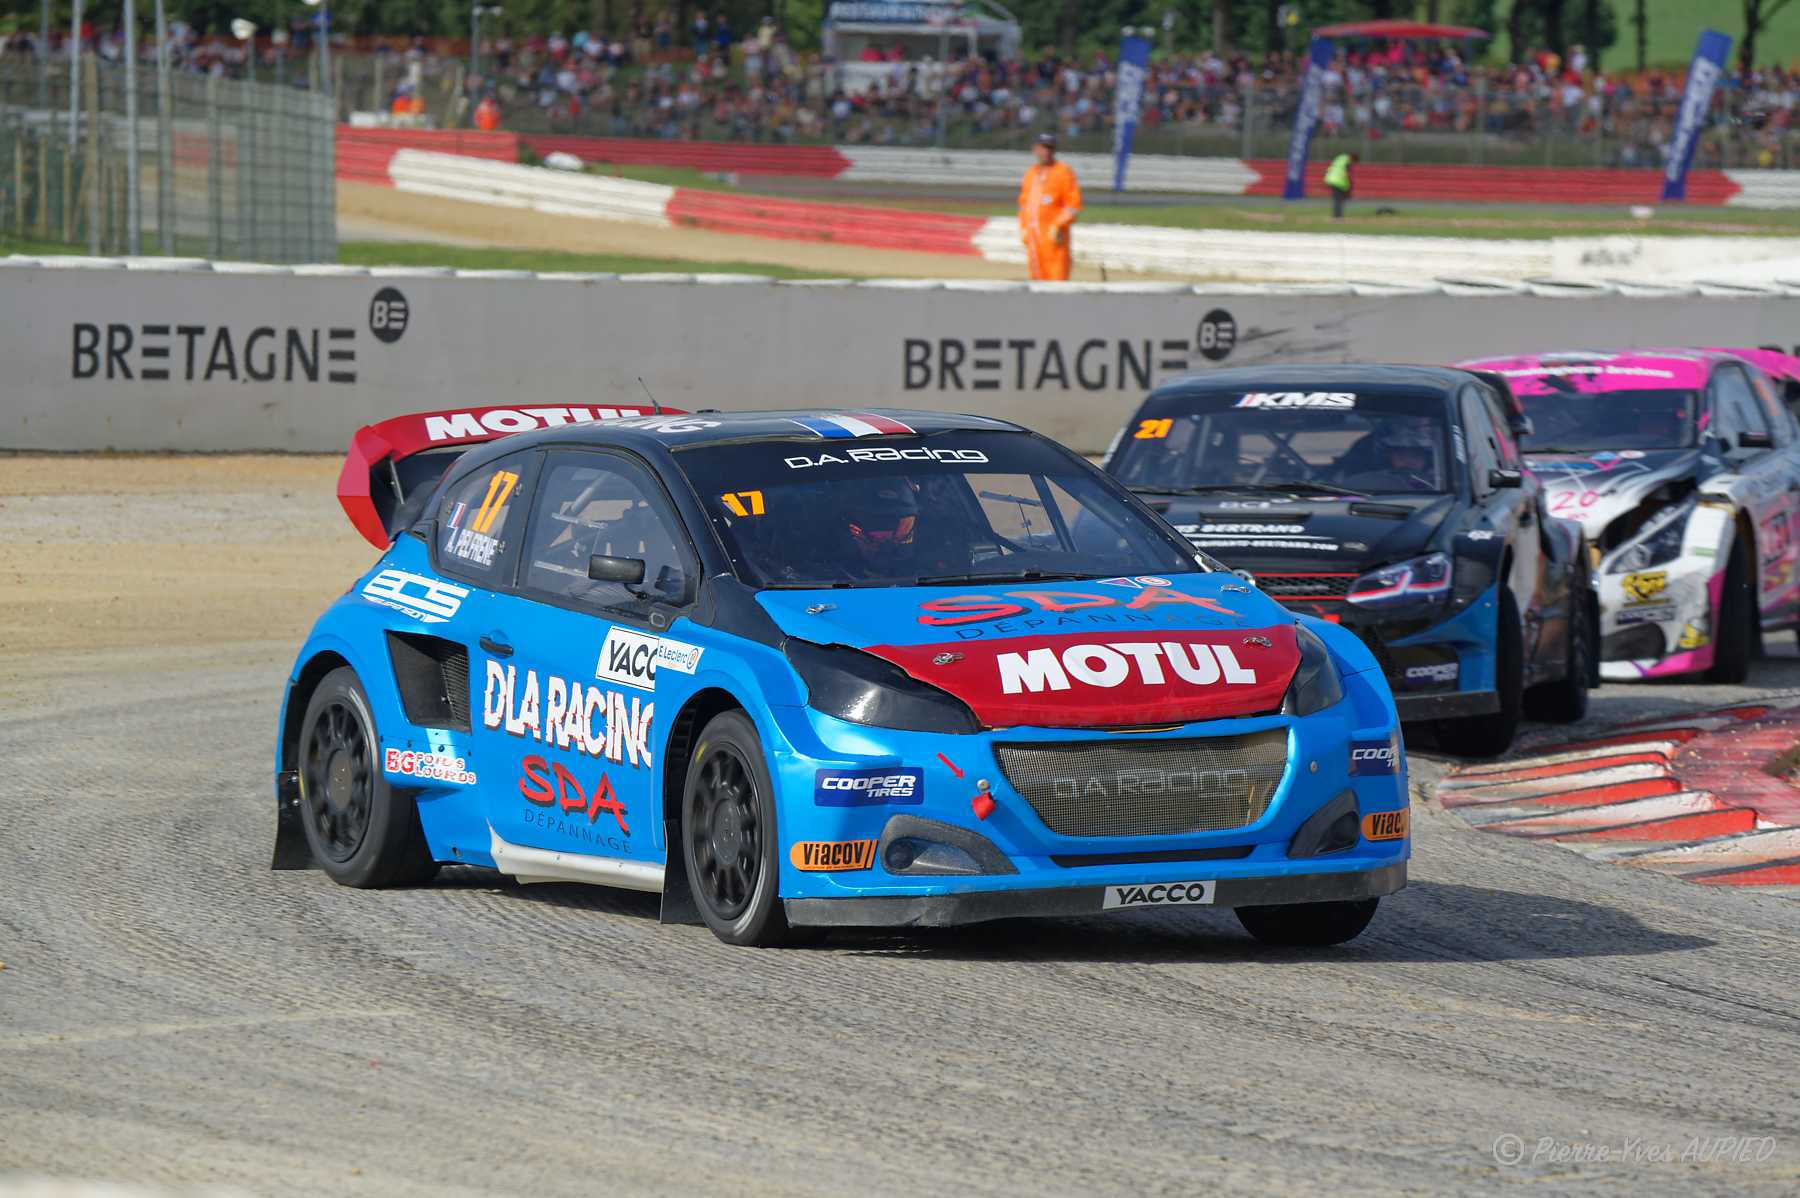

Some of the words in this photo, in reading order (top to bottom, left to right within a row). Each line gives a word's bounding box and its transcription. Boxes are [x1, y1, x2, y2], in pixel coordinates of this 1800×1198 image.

[72, 323, 357, 384] BRETAGNE
[903, 339, 1190, 391] BRETAGNE
[1134, 418, 1173, 439] 21
[472, 470, 519, 533] 17
[721, 489, 766, 518] 17
[1201, 524, 1305, 534] BERTRAND
[916, 587, 1244, 627] SDA
[996, 642, 1257, 695] MOTUL
[484, 659, 541, 739] DLA
[386, 750, 415, 773] BG
[518, 753, 631, 835] SDA
[821, 775, 917, 790] COOPER
[867, 787, 914, 798] TIRES
[1115, 883, 1205, 905] YACCO
